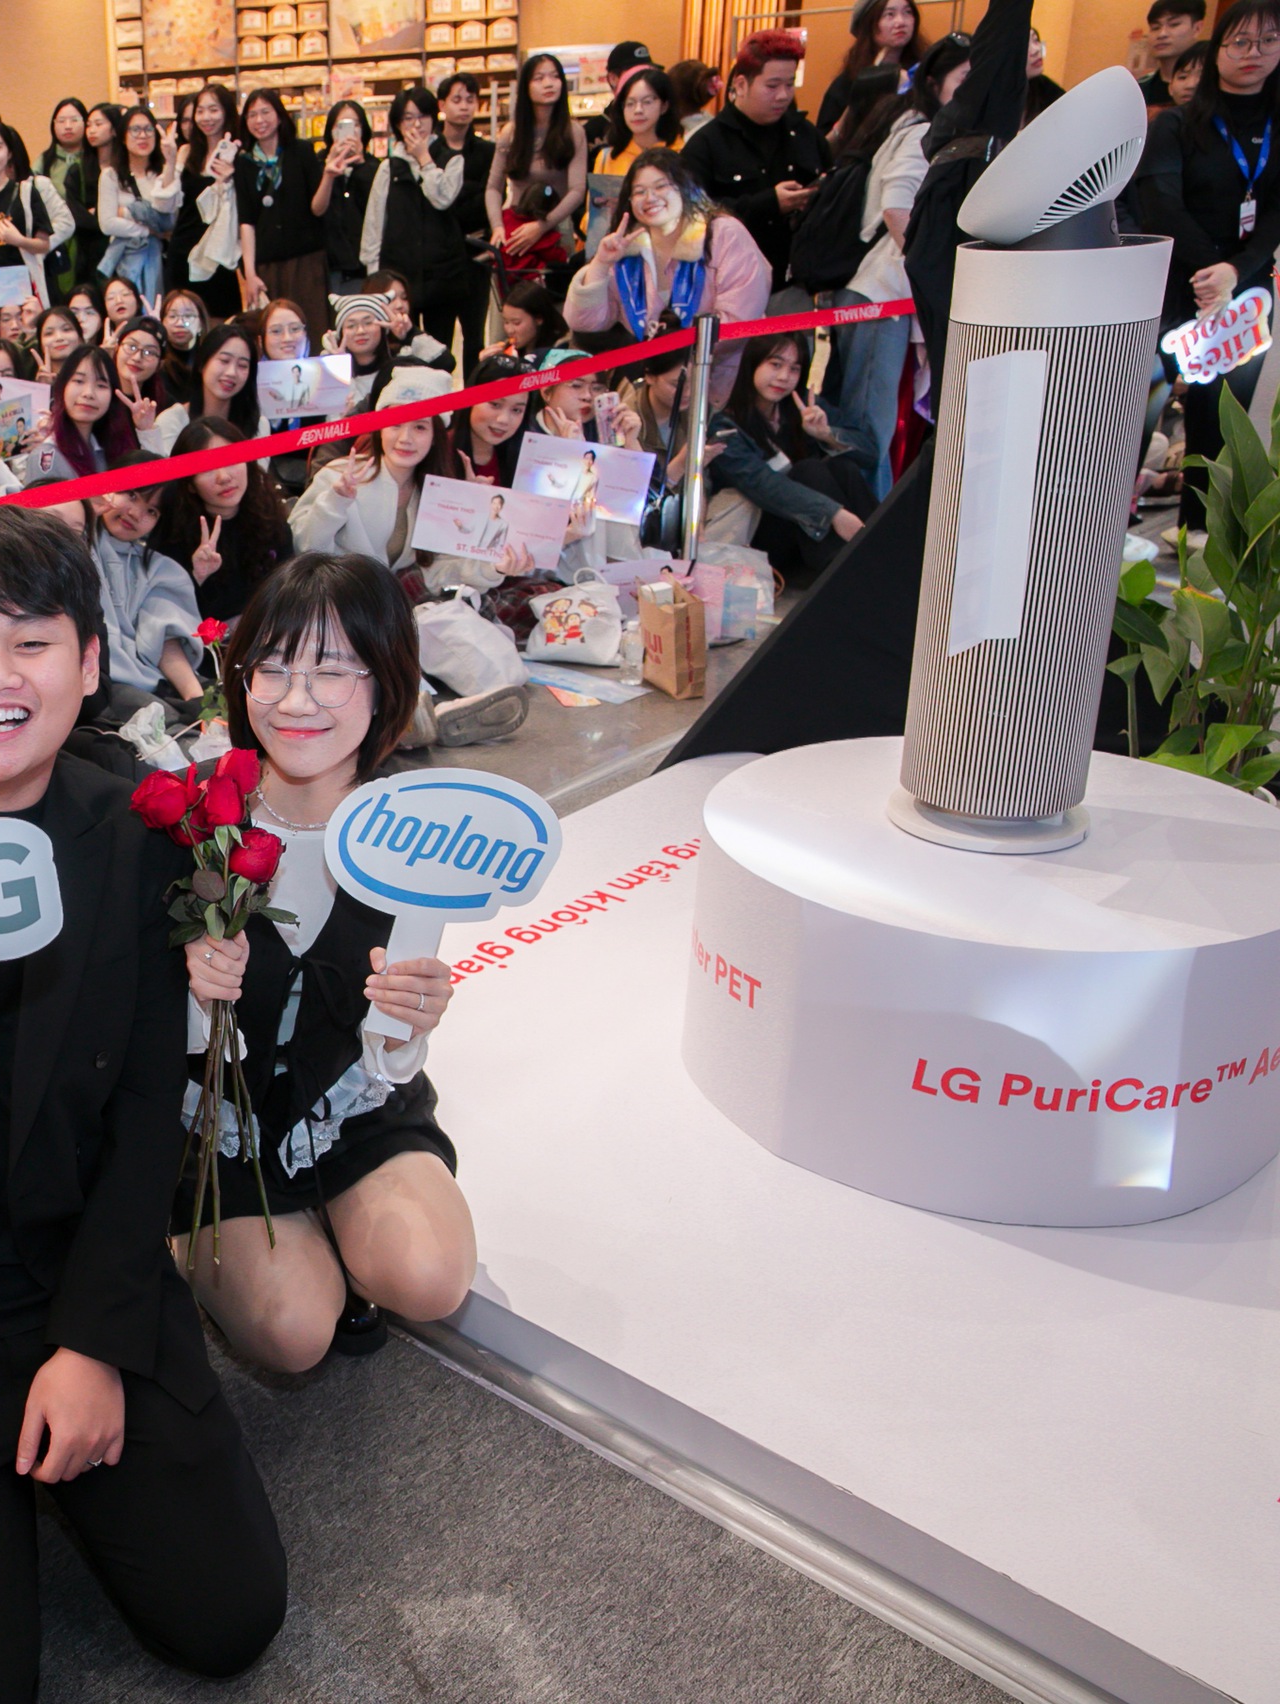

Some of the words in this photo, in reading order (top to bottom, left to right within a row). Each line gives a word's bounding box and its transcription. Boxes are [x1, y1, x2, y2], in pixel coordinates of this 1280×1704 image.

[324, 422, 351, 440] MALL
[356, 793, 546, 893] hoplong
[504, 890, 628, 945] không
[715, 953, 762, 1009] PET
[911, 1058, 982, 1104] LG
